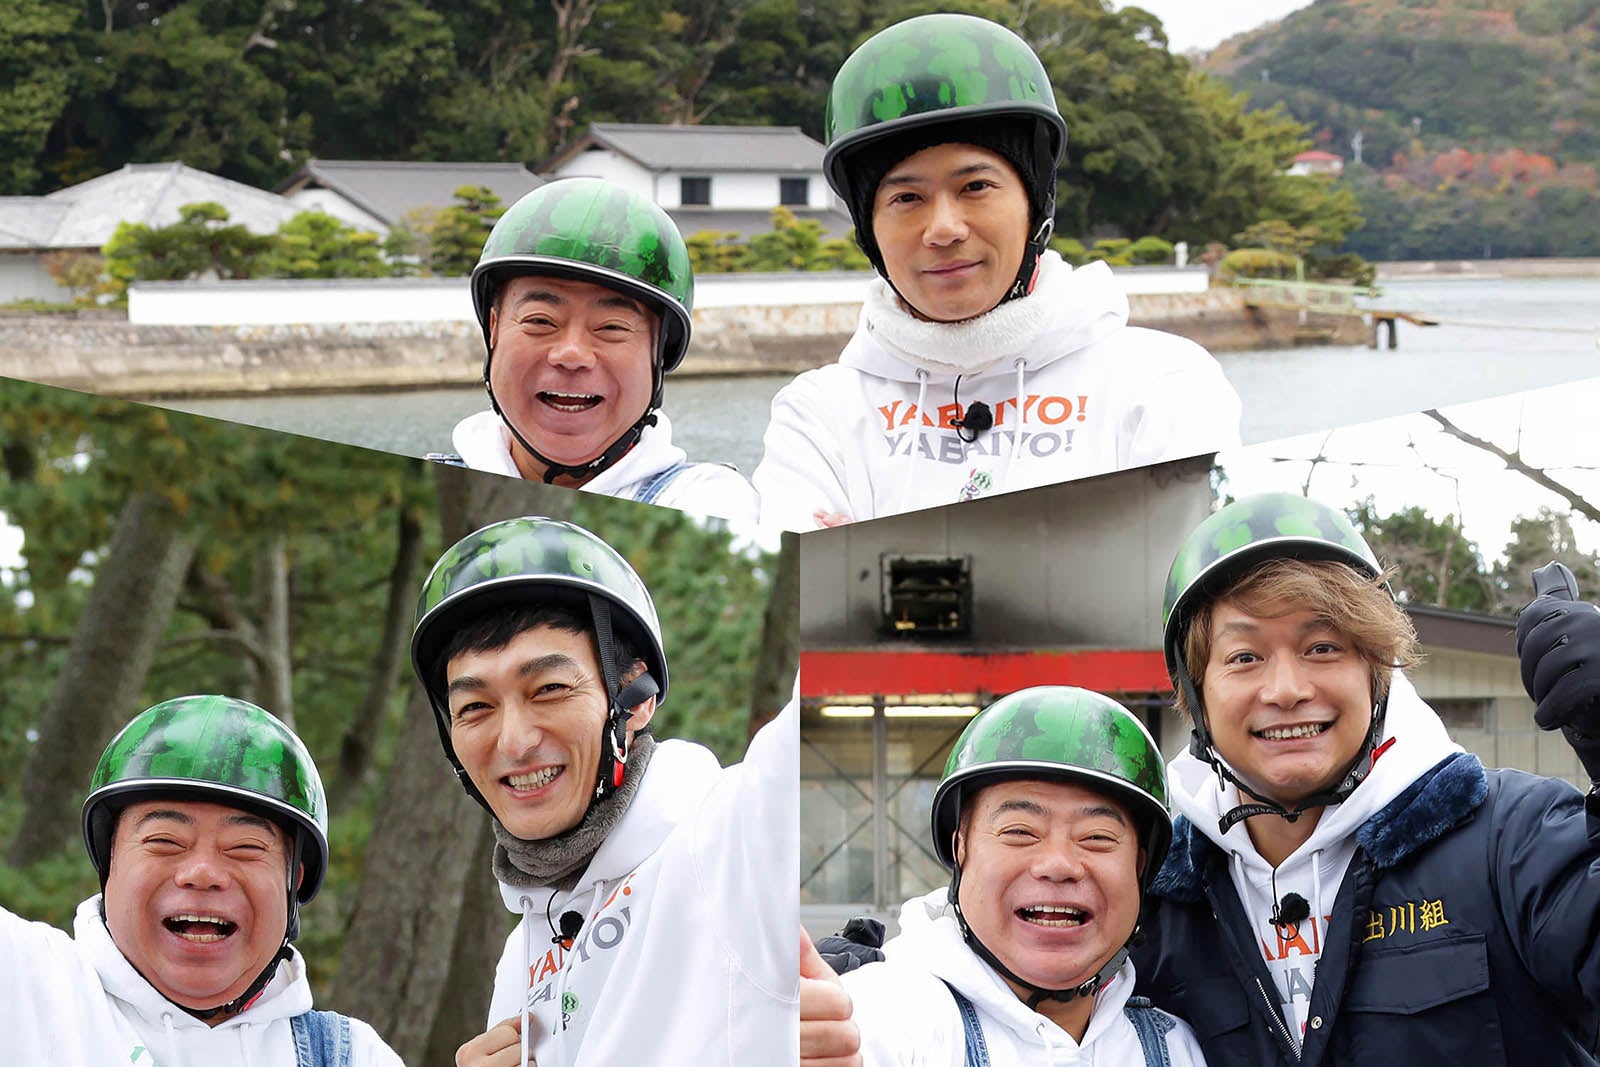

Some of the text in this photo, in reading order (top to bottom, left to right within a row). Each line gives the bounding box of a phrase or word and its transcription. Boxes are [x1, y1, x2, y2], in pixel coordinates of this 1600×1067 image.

[878, 395, 1088, 430] YABIYO!
[1362, 899, 1449, 943] 出川組
